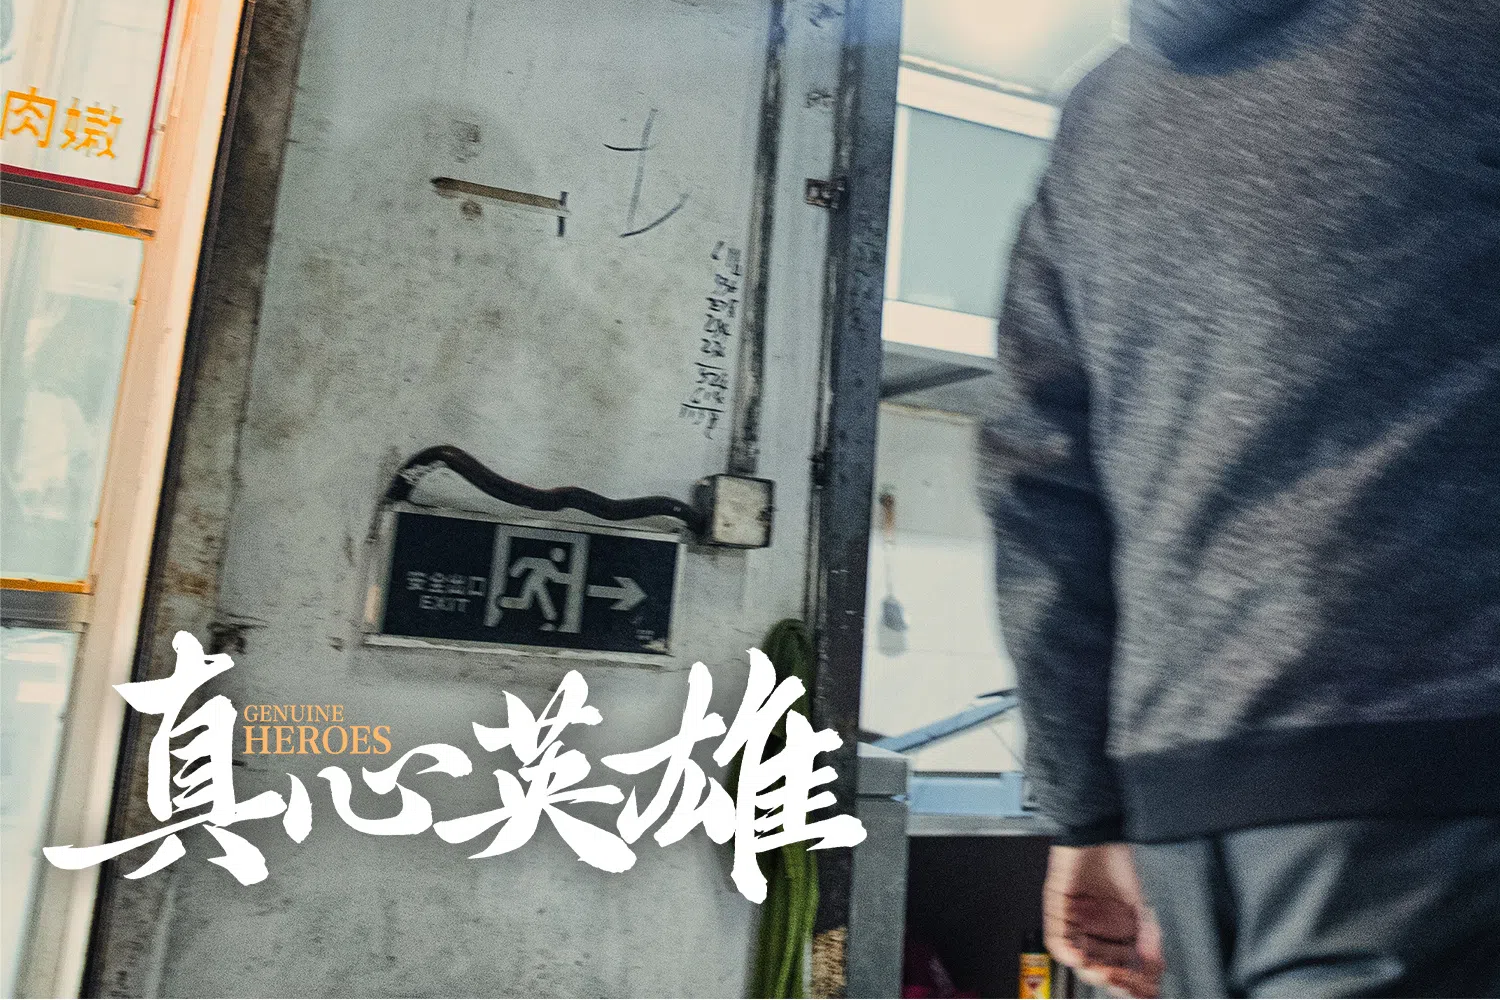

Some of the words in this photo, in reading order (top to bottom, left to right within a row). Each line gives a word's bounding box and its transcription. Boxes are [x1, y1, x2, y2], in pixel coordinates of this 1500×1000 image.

[0, 86, 123, 160] 肉嫩
[405, 570, 487, 598] 安全出口
[418, 596, 471, 613] EXIT
